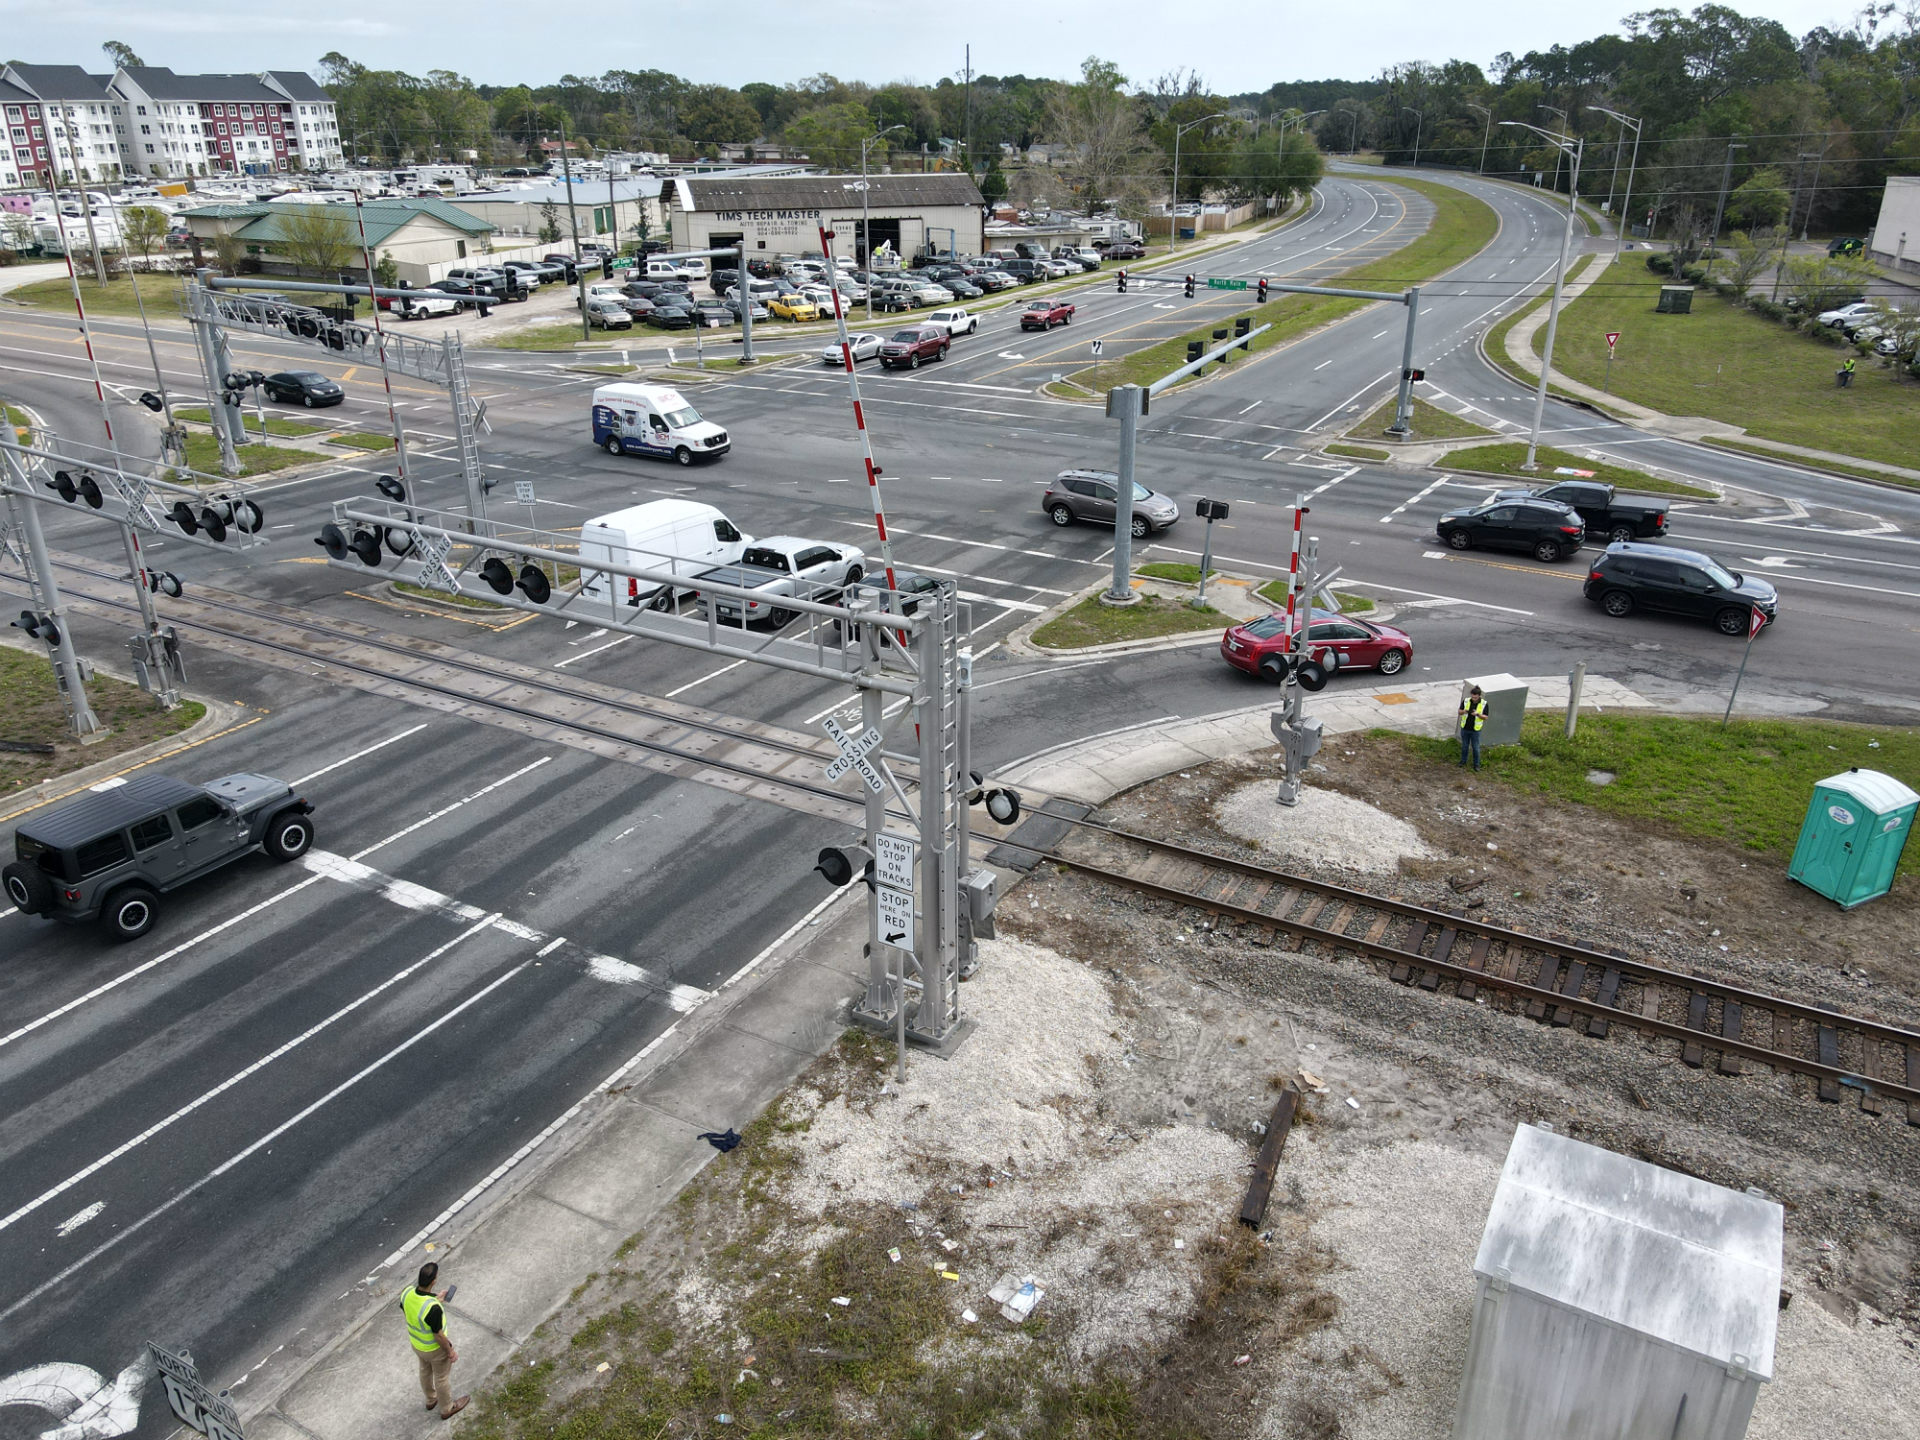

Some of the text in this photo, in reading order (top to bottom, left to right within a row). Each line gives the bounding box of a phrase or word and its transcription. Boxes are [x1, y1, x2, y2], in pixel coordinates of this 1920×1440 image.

[747, 211, 773, 220] TECH
[777, 210, 820, 219] MASTER
[125, 480, 148, 525] CROSSING
[412, 531, 431, 558] RAIL
[418, 538, 450, 585] CROSSING
[824, 719, 881, 790] RAIL ROAD
[827, 730, 879, 780] CROSSING
[877, 838, 911, 854] DO NOT
[883, 850, 906, 861] STOP
[888, 862, 901, 873] ON
[877, 869, 912, 887] TRACKS
[881, 892, 909, 908] STOP
[880, 903, 911, 919] HERE ON
[884, 914, 906, 929] RED
[151, 1347, 199, 1383] NORTH
[193, 1385, 240, 1429] SOUTH
